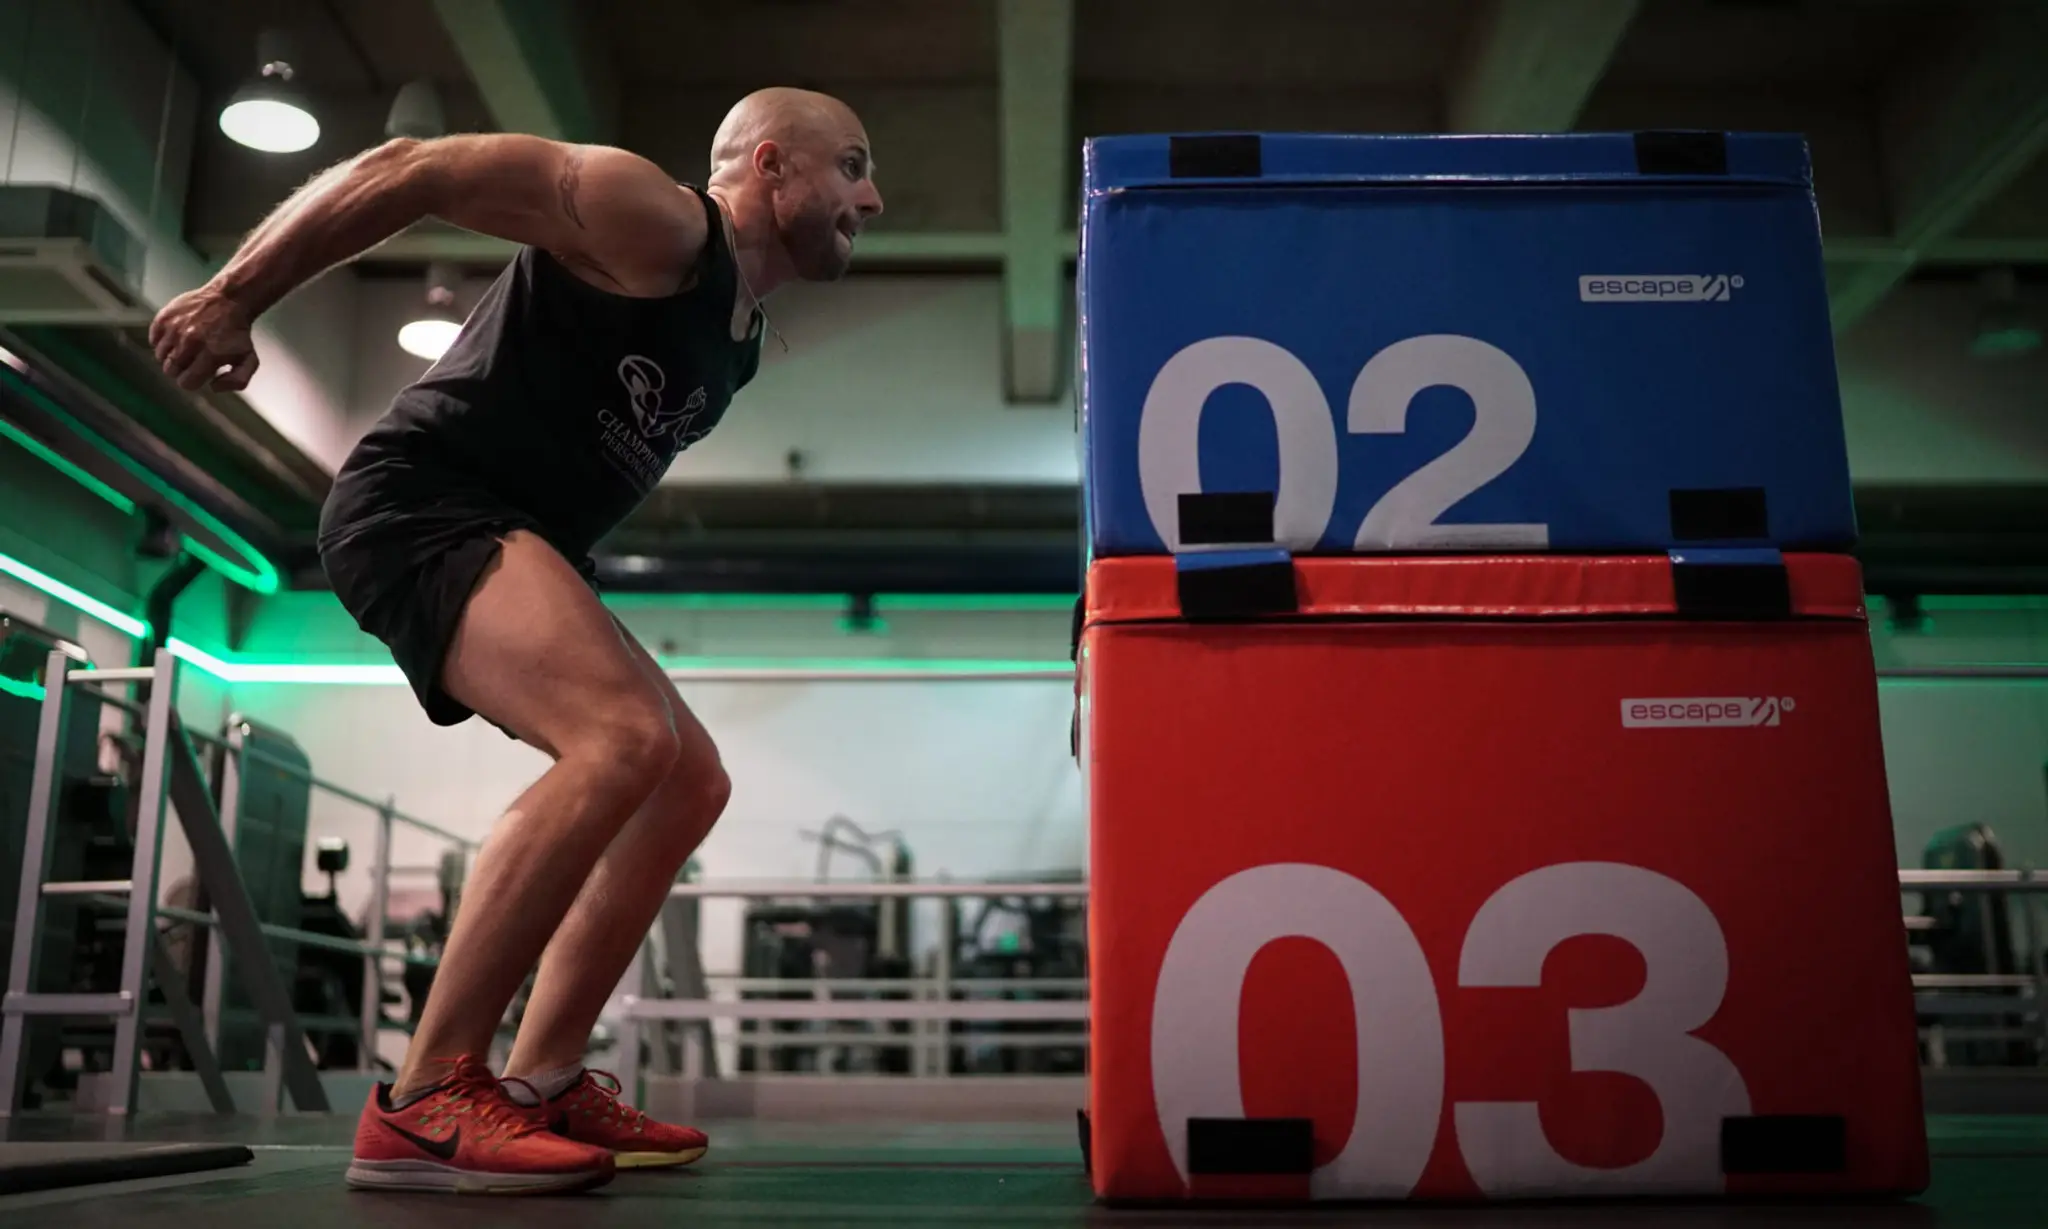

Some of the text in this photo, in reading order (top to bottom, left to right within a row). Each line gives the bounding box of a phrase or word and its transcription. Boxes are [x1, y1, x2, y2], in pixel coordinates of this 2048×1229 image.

[1588, 280, 1694, 297] escape
[1138, 333, 1549, 552] 02
[1630, 703, 1742, 722] escape
[1150, 860, 1753, 1199] 03
